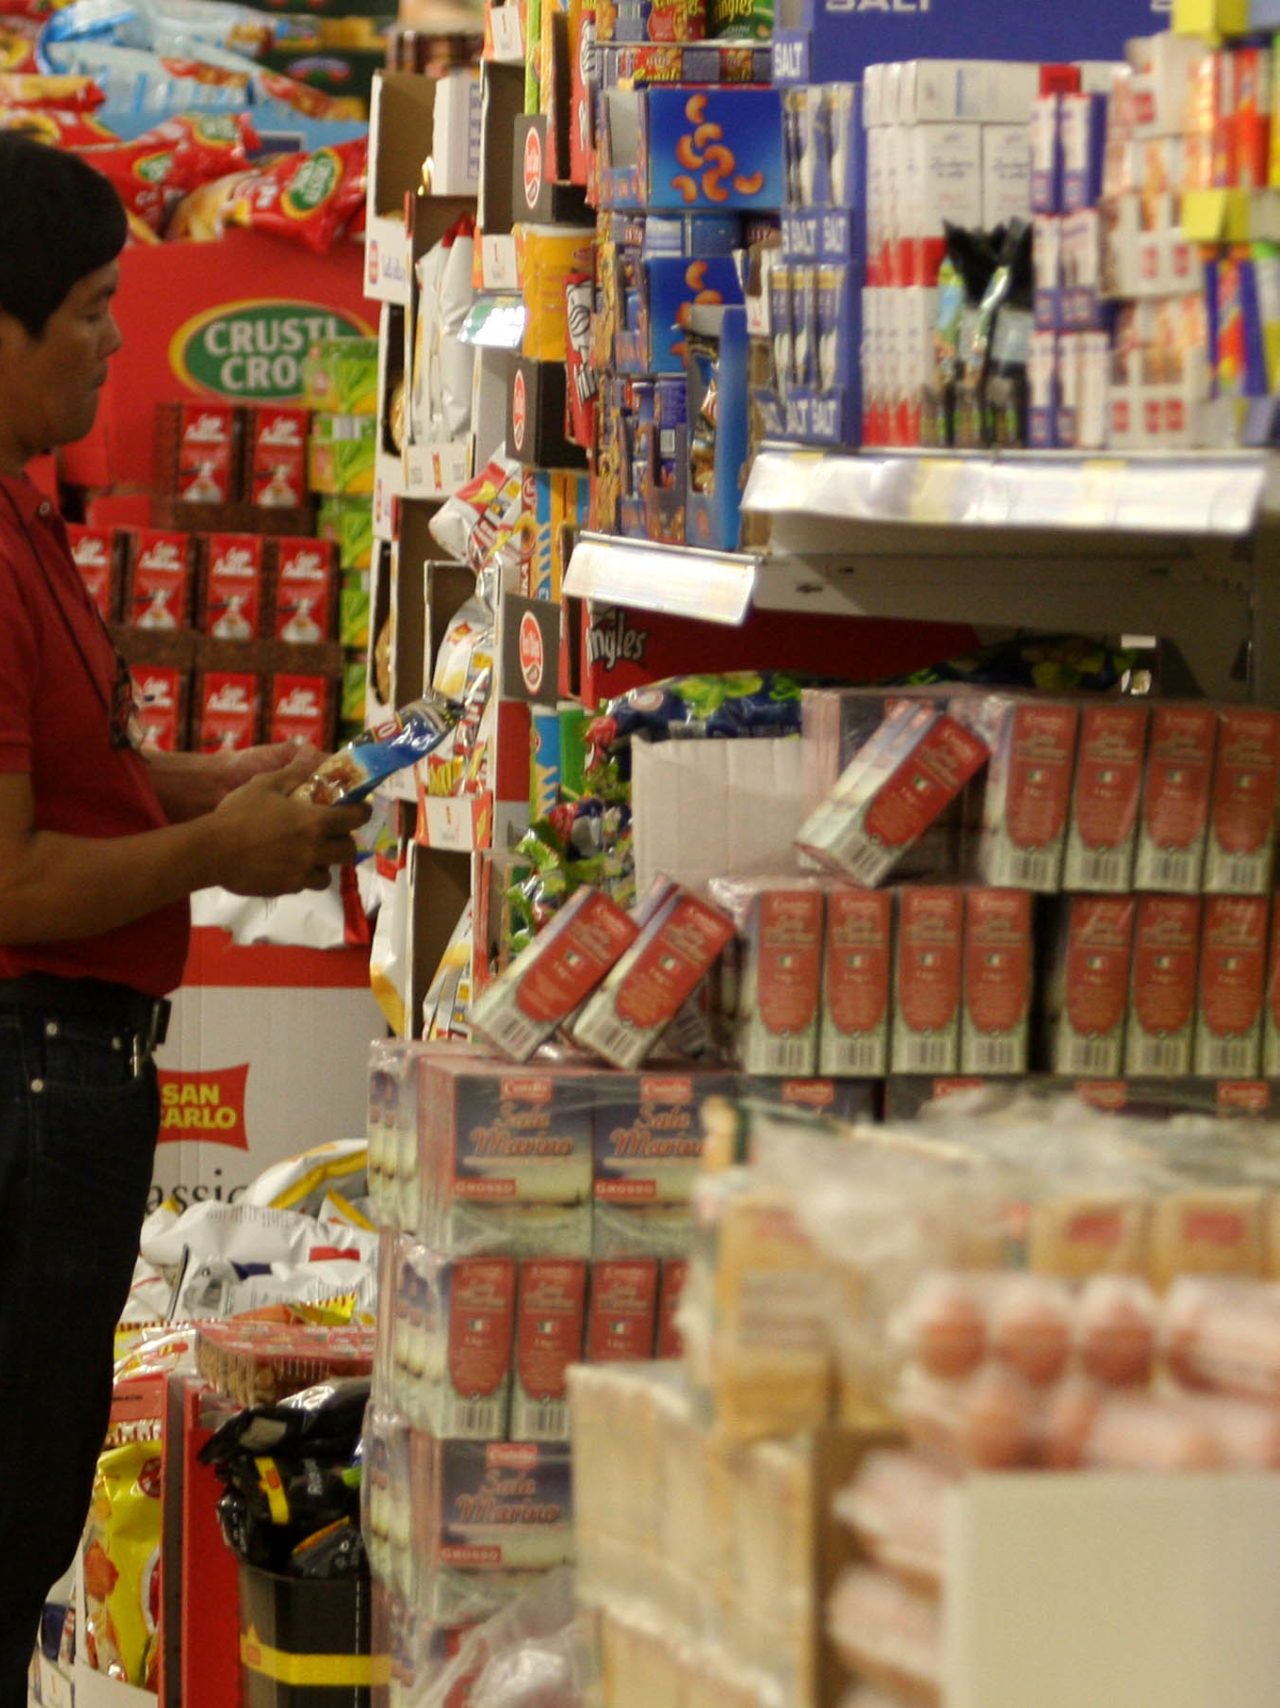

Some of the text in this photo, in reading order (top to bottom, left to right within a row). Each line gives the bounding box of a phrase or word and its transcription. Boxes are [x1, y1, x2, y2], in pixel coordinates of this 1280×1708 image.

[221, 355, 303, 390] CRO
[162, 1083, 220, 1105] SAN
[161, 1106, 237, 1129] ARLO
[609, 1126, 704, 1157] Marin
